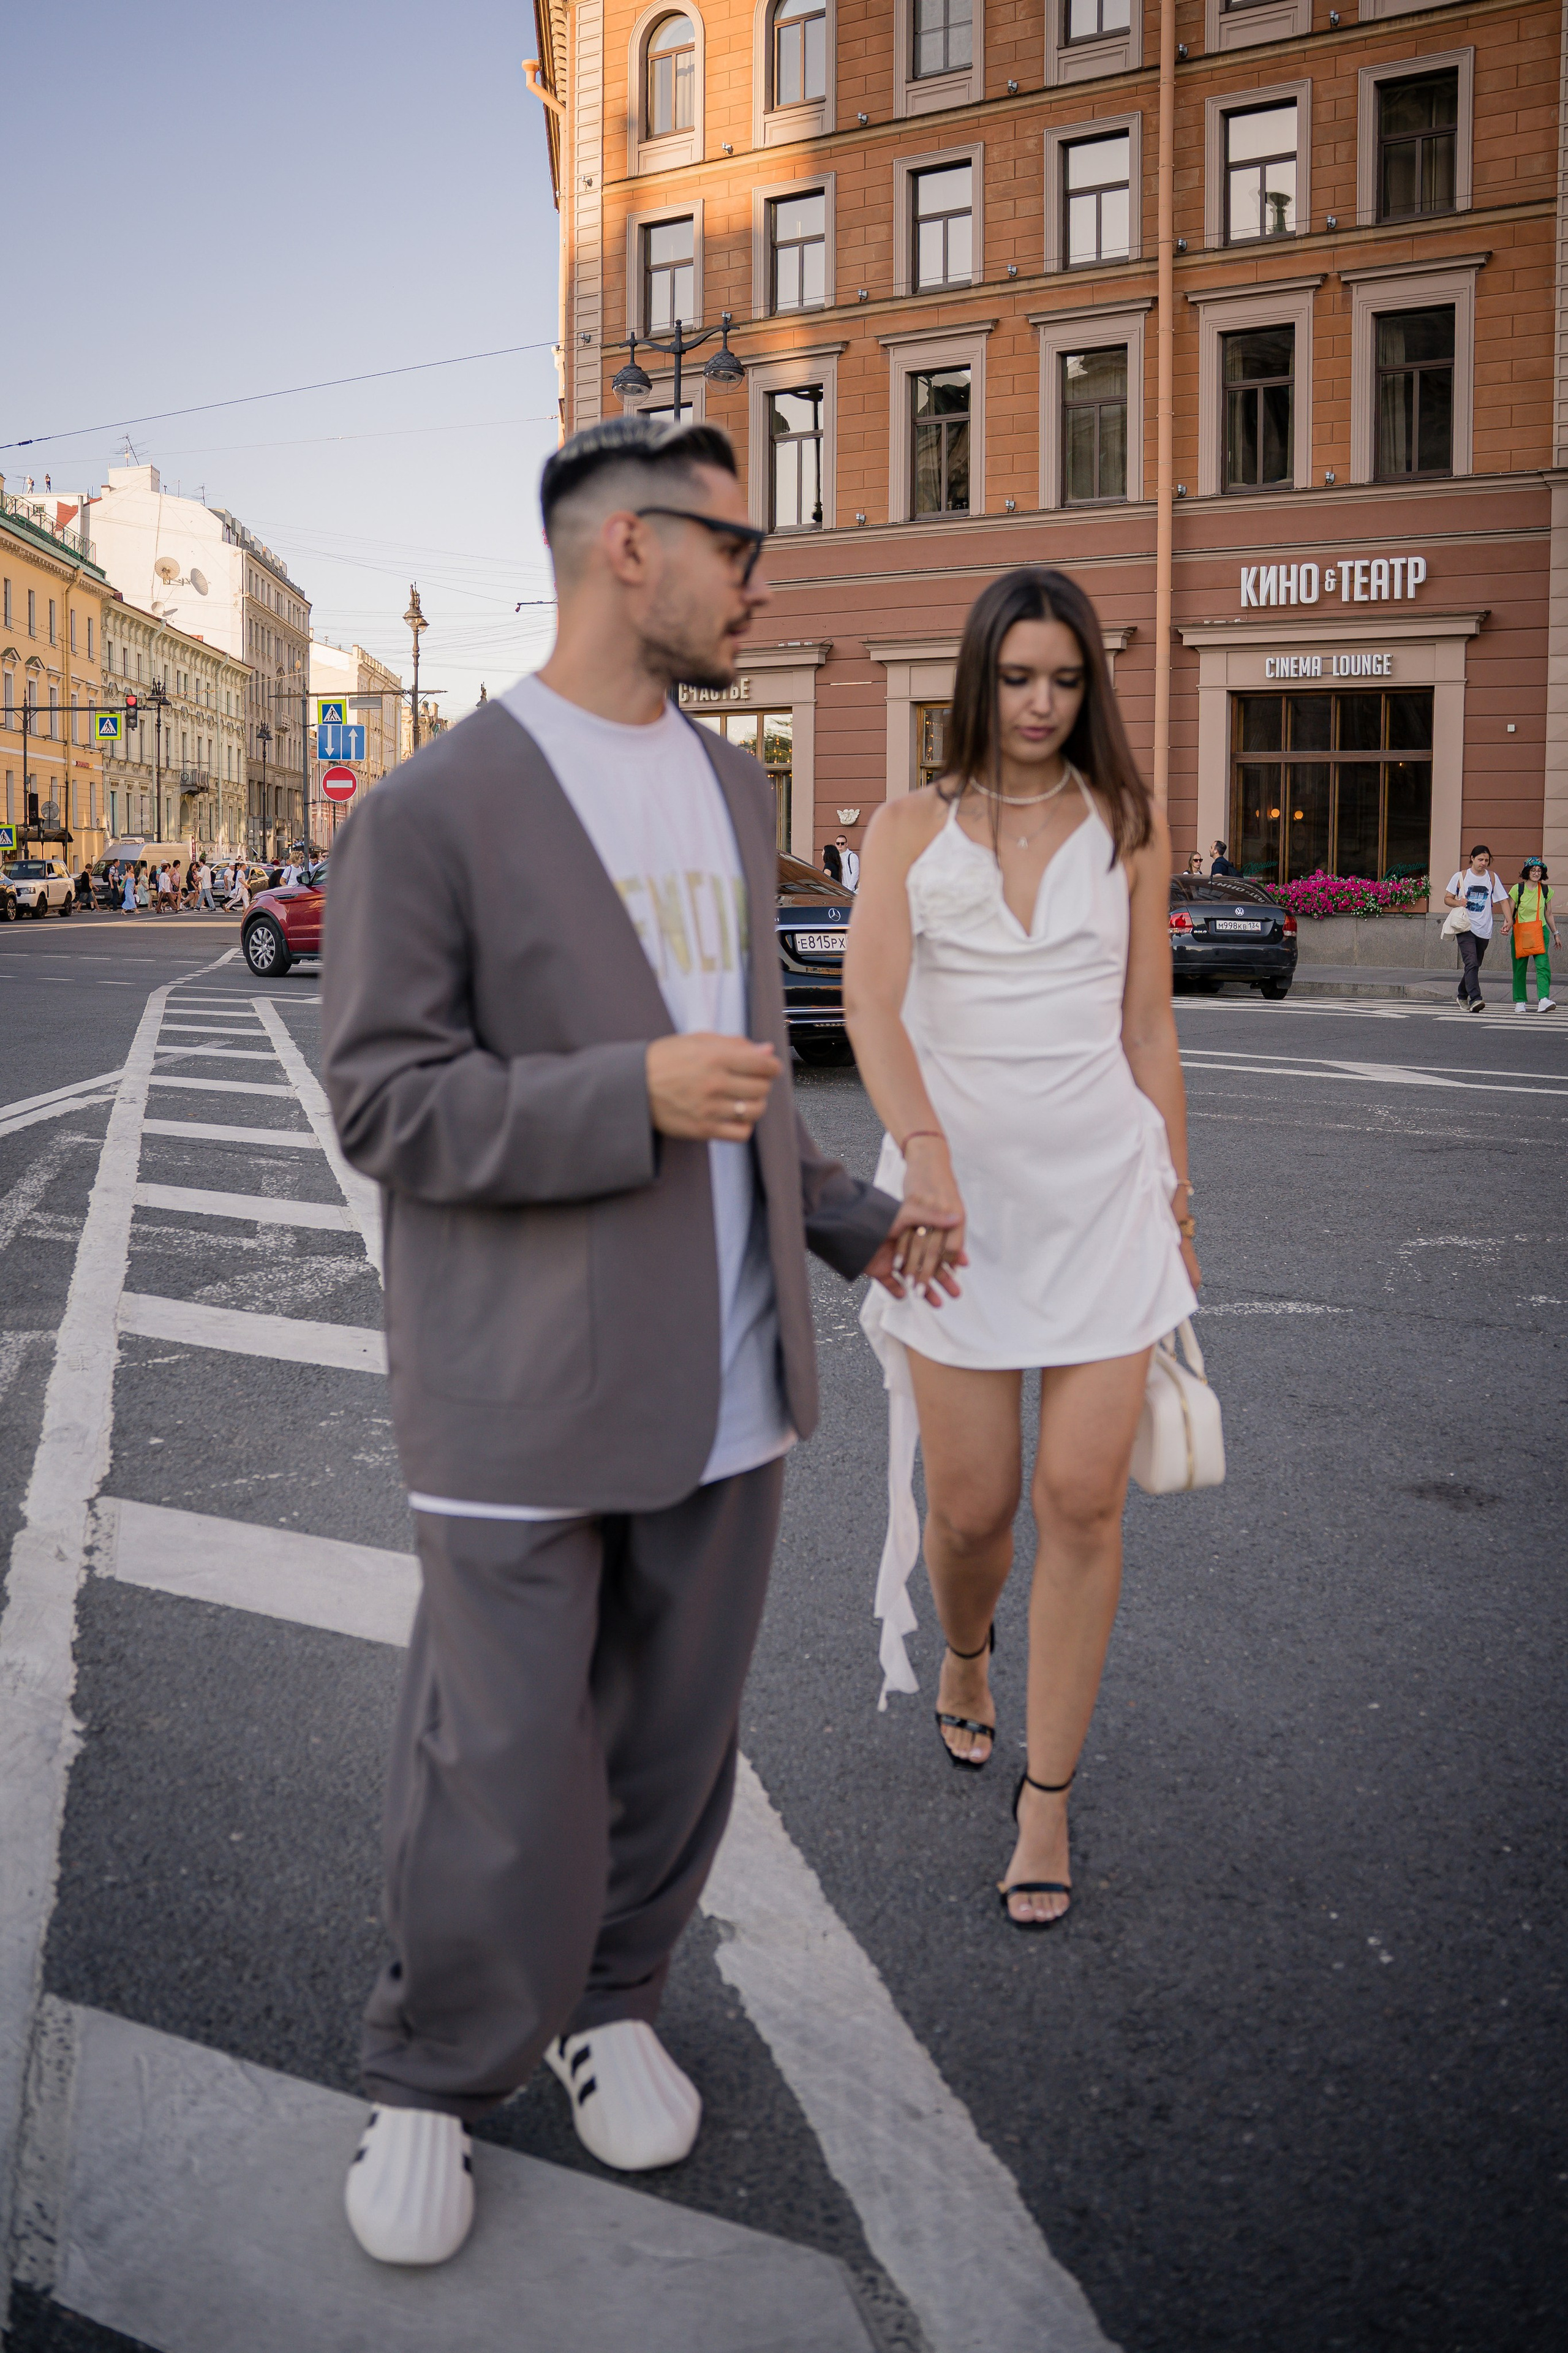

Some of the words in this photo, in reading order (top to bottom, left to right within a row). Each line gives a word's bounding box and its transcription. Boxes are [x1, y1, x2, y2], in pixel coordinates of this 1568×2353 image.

[1240, 563, 1319, 607] КИНО
[1325, 568, 1336, 592] &
[1337, 556, 1427, 602] ТЕАТР
[1265, 655, 1322, 678] CINEMA
[1332, 654, 1392, 676] LOUNGE
[800, 935, 846, 949] Е815РХ
